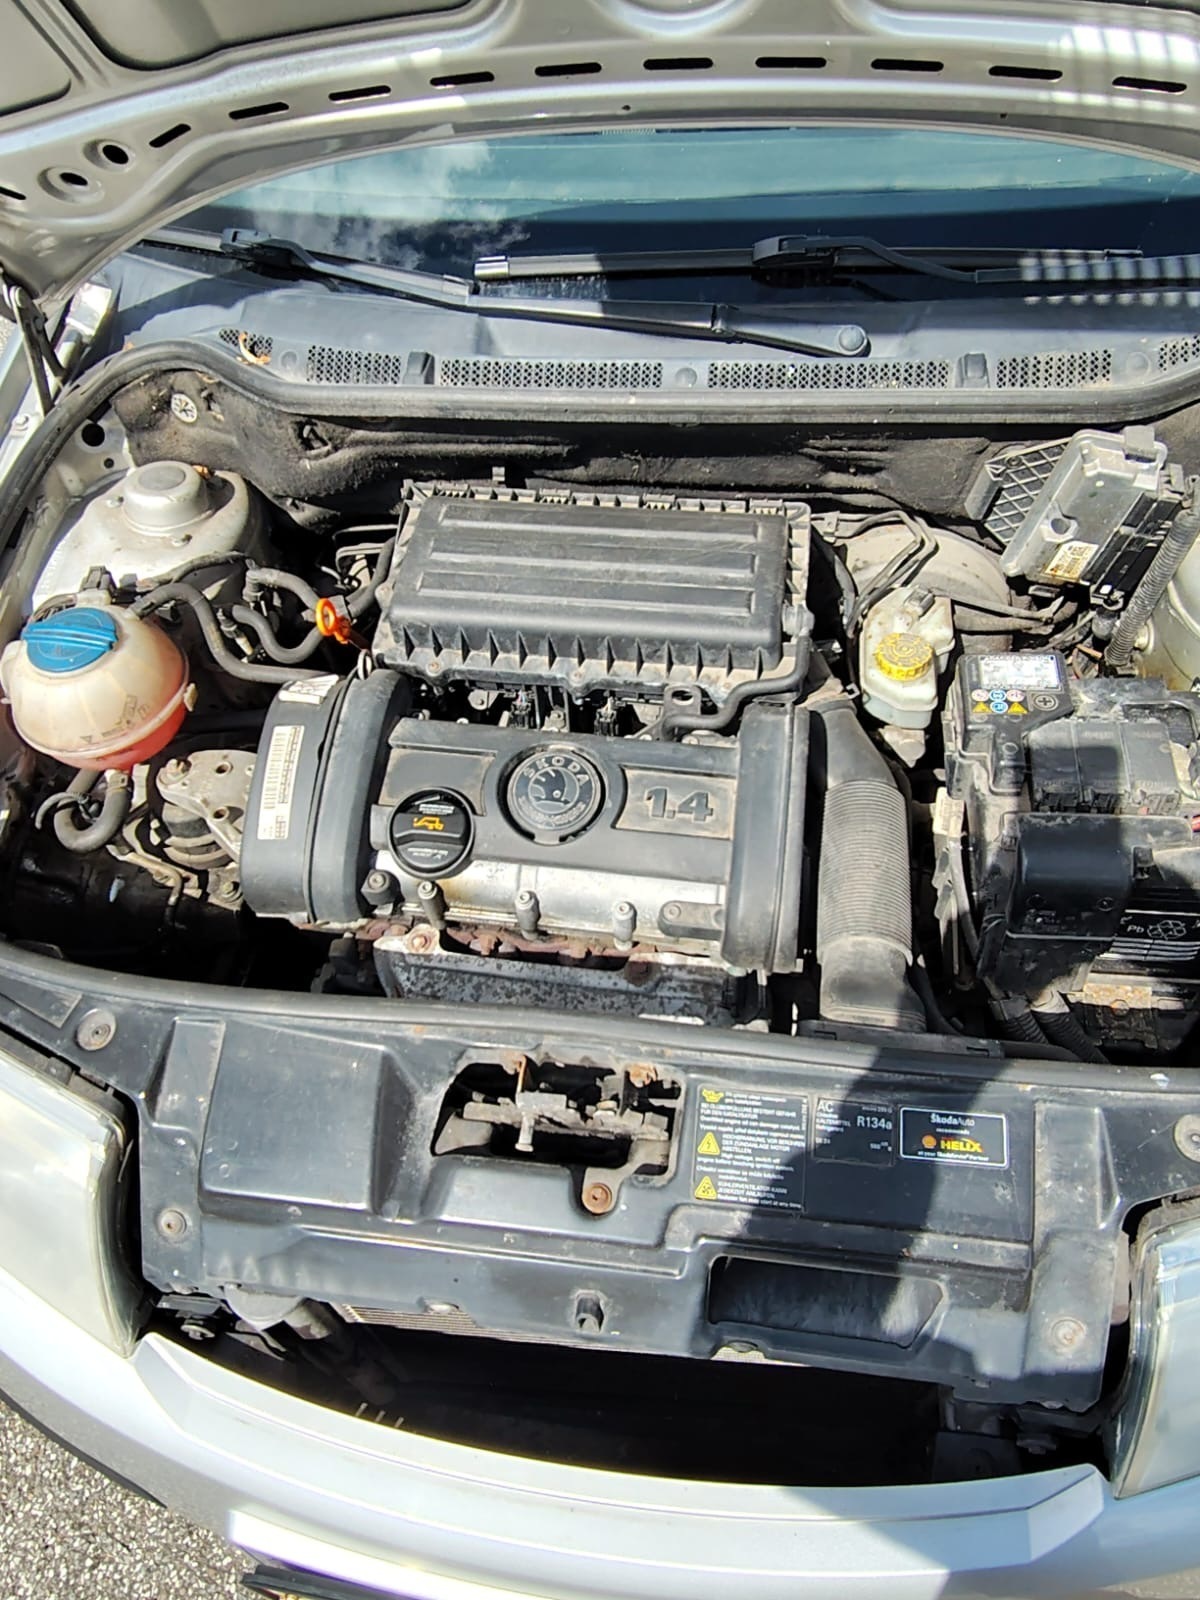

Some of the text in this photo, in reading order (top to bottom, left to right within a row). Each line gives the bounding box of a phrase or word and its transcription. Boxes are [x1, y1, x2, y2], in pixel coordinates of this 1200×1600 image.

[644, 786, 714, 824] 1.4
[817, 1102, 834, 1113] AC
[856, 1115, 893, 1131] R134a
[941, 1140, 983, 1153] HELIX
